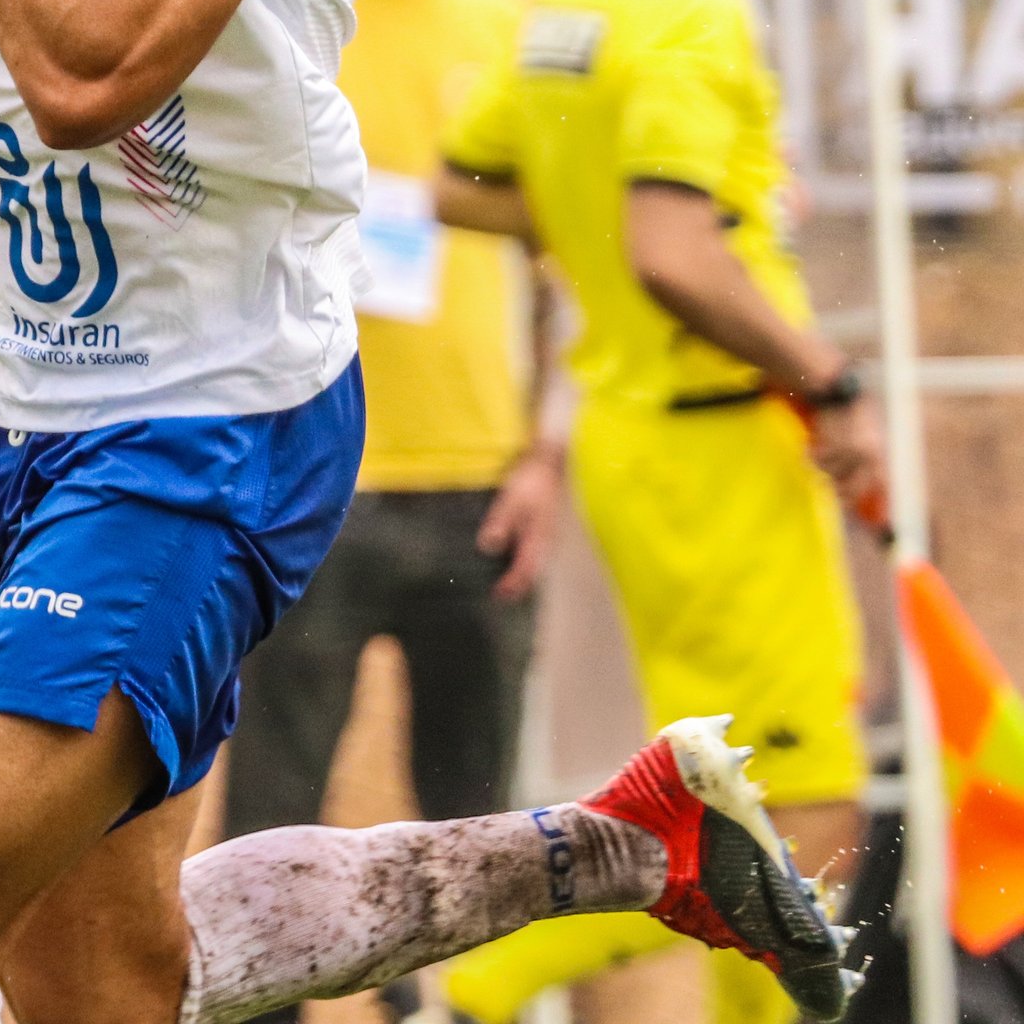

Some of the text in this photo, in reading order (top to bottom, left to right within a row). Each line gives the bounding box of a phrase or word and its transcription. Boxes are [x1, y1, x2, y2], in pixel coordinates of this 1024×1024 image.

[10, 305, 120, 348] insuran
[76, 354, 86, 364] &
[89, 352, 150, 367] SEGUROS
